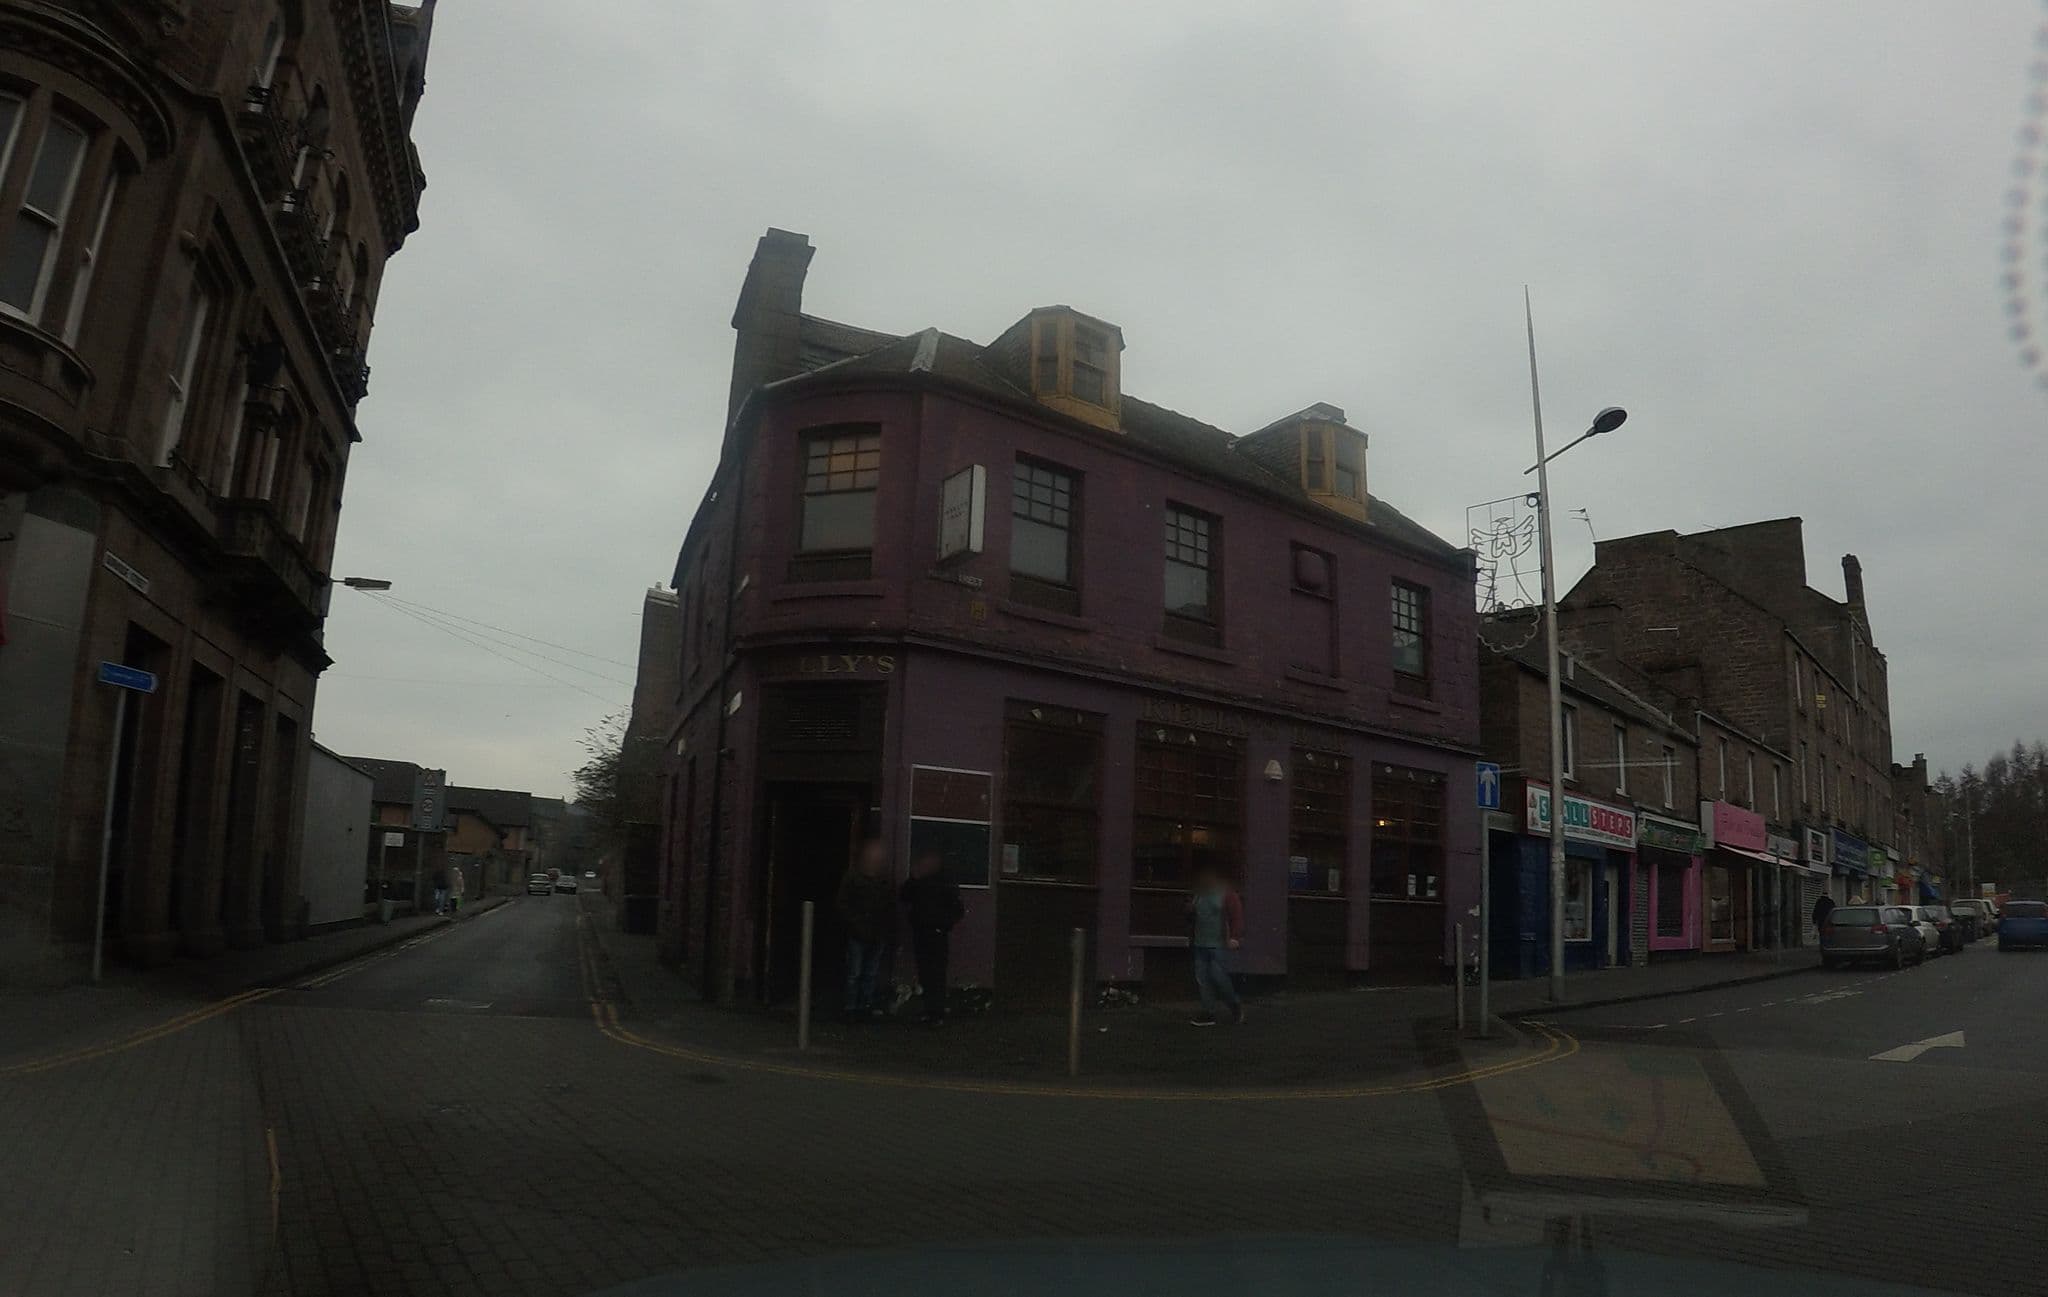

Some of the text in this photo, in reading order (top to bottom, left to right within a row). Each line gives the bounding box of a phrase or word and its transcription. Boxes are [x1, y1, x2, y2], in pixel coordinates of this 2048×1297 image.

[776, 654, 896, 674] LLY'S
[1540, 799, 1632, 835] SALL STEPS
